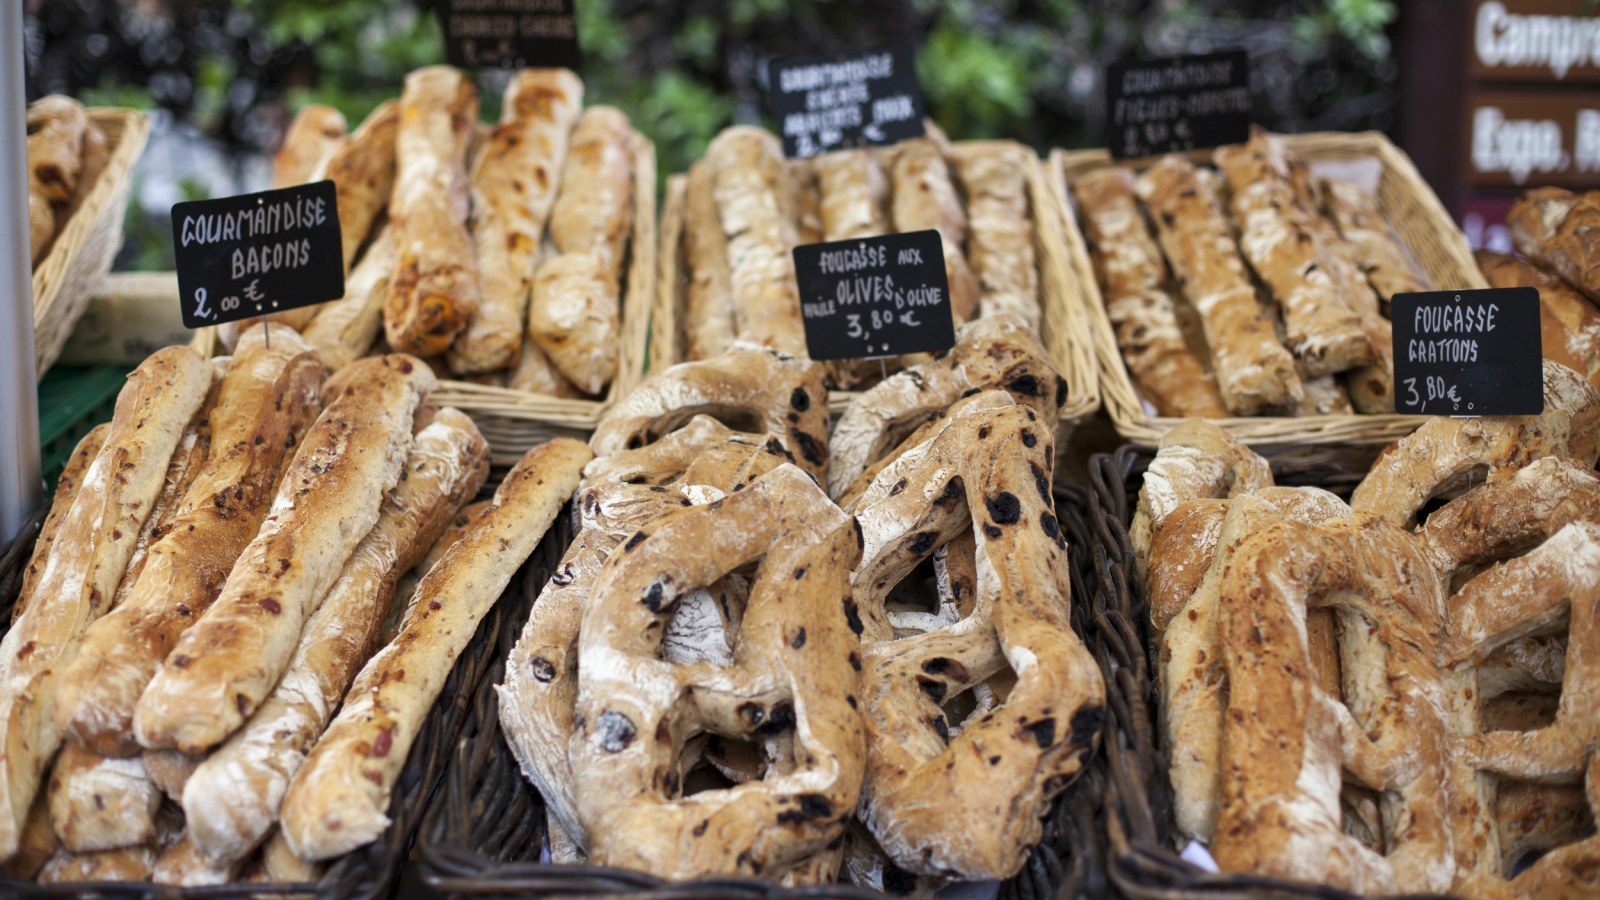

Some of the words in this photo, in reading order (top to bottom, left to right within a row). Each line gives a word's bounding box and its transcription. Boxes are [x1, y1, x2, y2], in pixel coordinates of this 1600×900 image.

[181, 195, 326, 247] GOURMANDISE
[232, 238, 311, 279] BACONS
[898, 248, 923, 265] AUX
[836, 273, 894, 305] OLIVES
[803, 296, 836, 318] HUILE
[1415, 303, 1499, 333] FOUGASSE
[1409, 338, 1478, 363] GRATTONS
